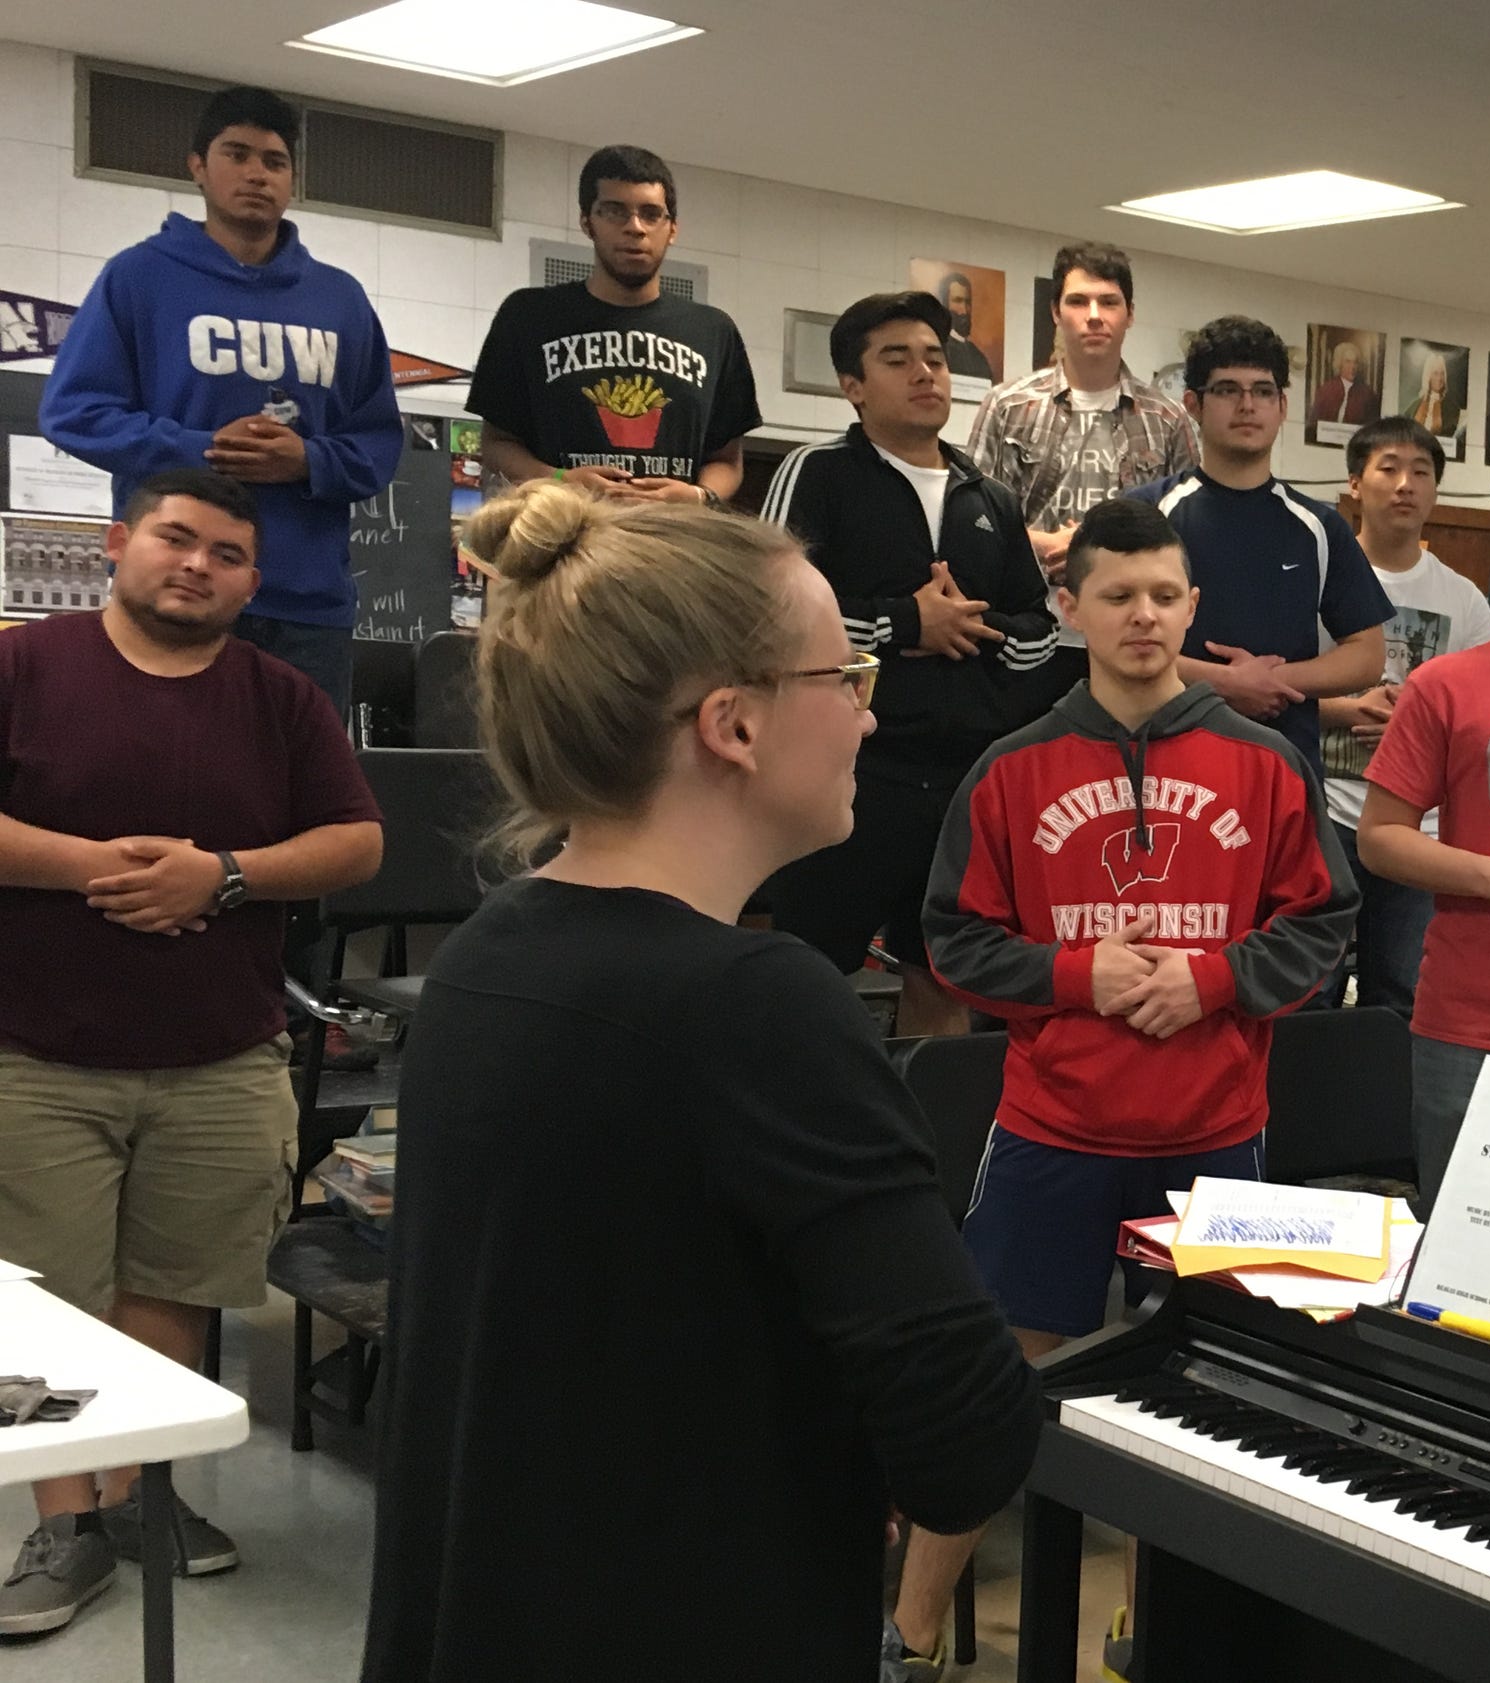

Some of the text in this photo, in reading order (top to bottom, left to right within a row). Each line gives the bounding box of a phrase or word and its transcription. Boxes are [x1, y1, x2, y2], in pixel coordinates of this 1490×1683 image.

[188, 314, 338, 389] CUW
[541, 330, 708, 388] EXERCISE?
[393, 367, 432, 379] NTENNIAL
[641, 455, 669, 475] YOU
[672, 456, 694, 478] SAI
[350, 520, 408, 545] anet
[373, 589, 405, 613] will
[409, 616, 425, 641] it
[1032, 776, 1252, 854] UNIVERSITY OF
